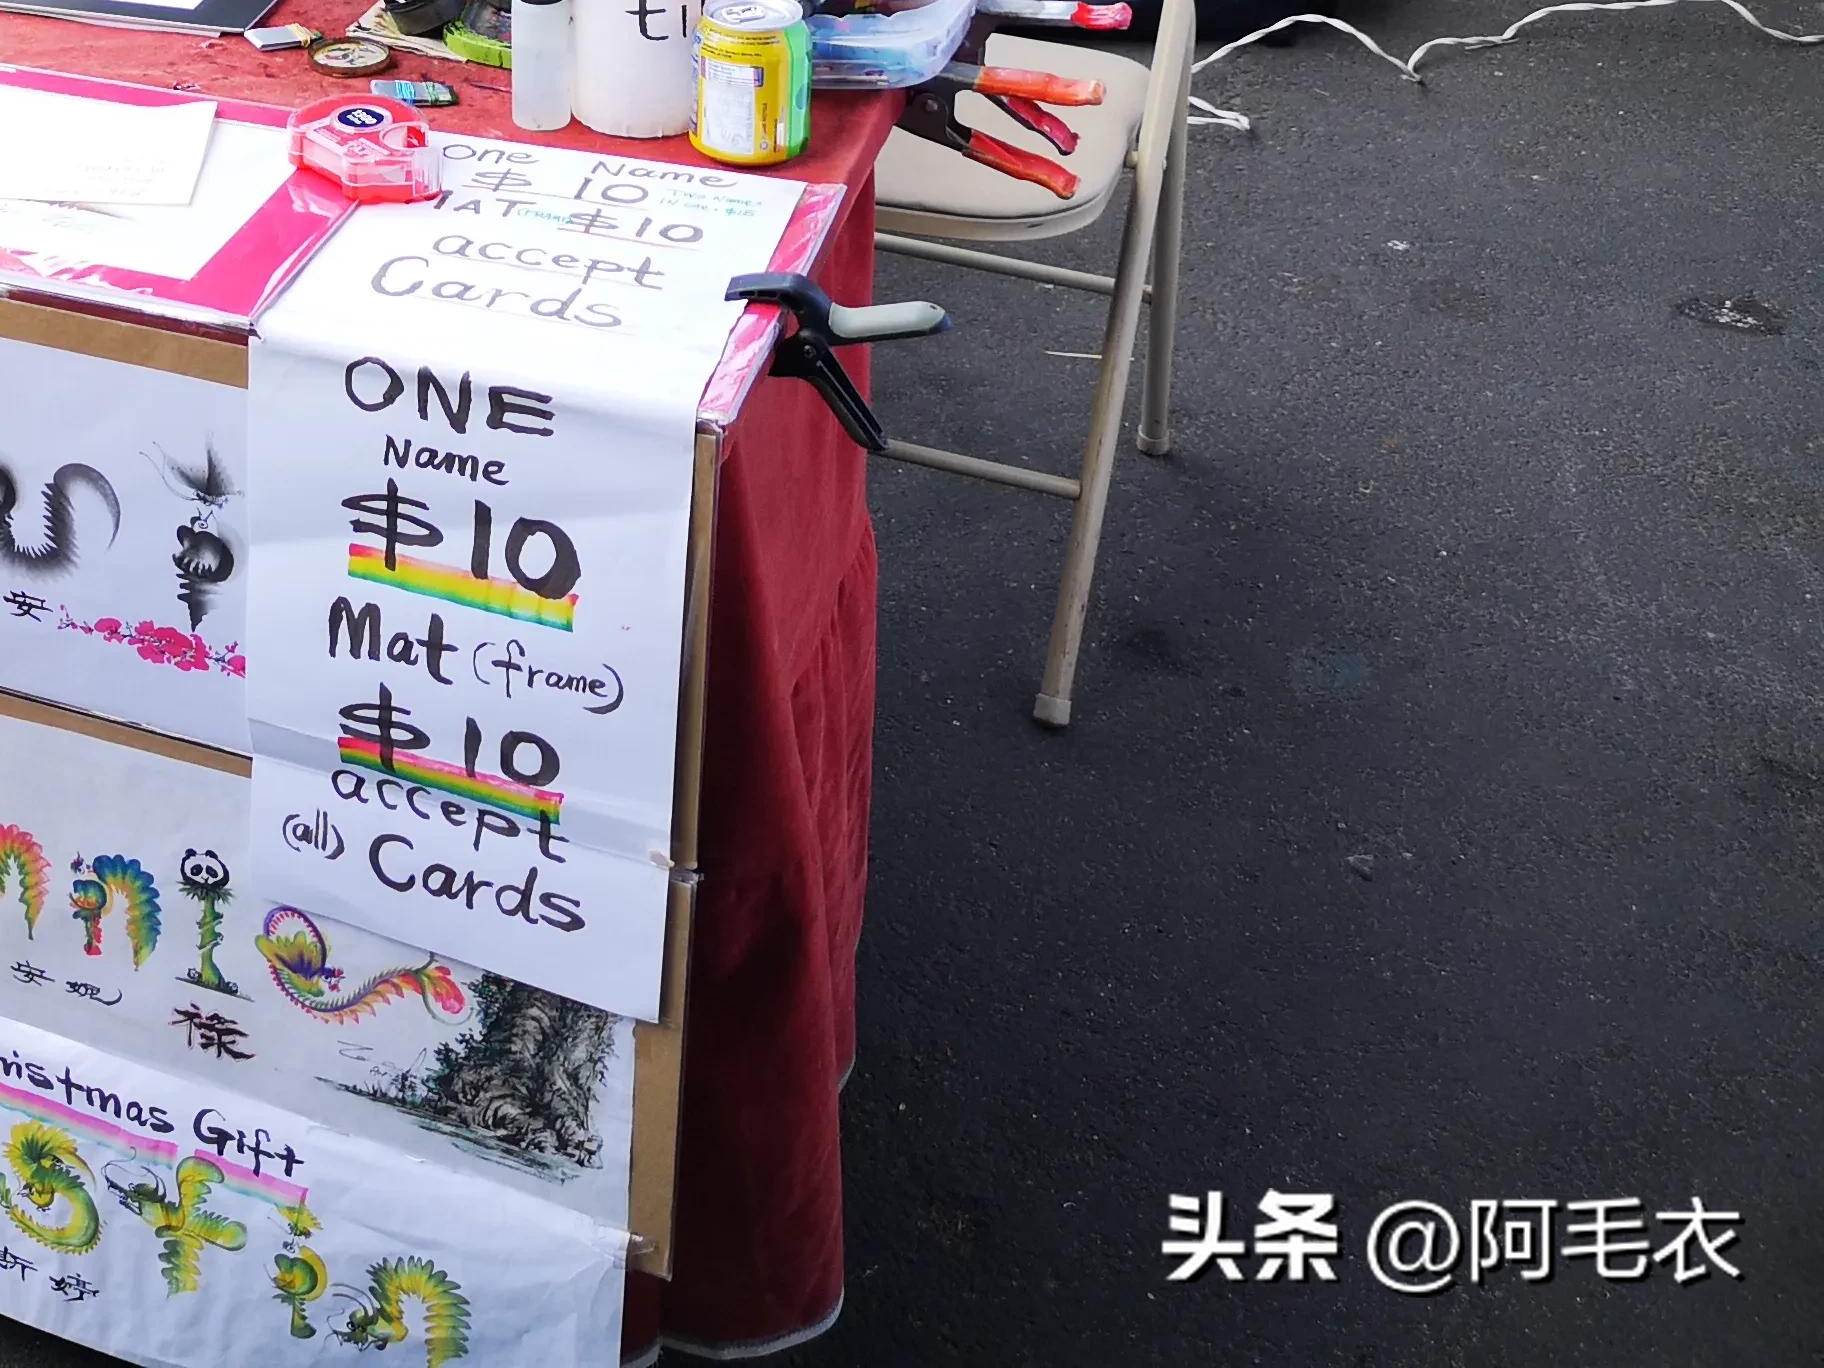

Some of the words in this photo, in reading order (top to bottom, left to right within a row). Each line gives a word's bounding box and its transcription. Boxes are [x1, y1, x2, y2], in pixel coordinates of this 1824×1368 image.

[441, 143, 540, 165] One
[590, 160, 738, 188] Name
[371, 256, 623, 328] Cards
[432, 236, 666, 290] accept
[345, 356, 555, 436] ONE
[383, 434, 510, 485] Name
[341, 477, 582, 600] $10
[328, 596, 459, 685] Mat
[473, 639, 623, 715] (frame)
[338, 682, 561, 787] $10
[331, 769, 570, 863] accept
[282, 808, 345, 860] (all)
[368, 833, 586, 931] Cards
[193, 1108, 305, 1178] Gift
